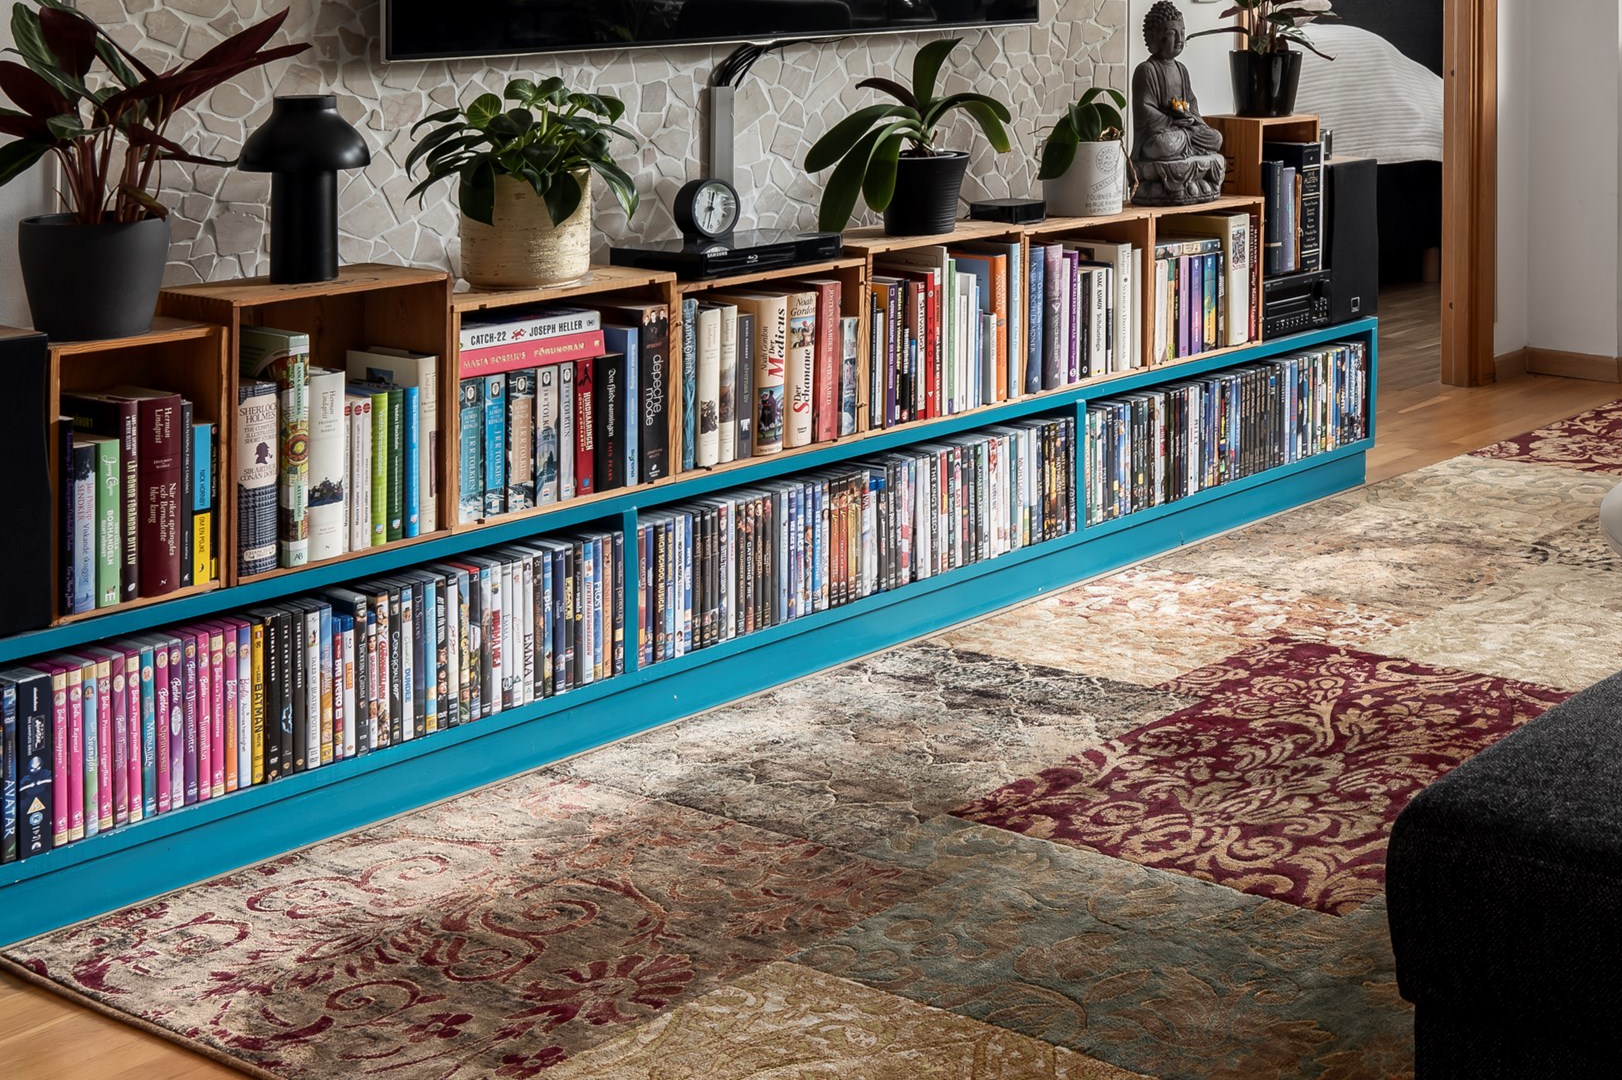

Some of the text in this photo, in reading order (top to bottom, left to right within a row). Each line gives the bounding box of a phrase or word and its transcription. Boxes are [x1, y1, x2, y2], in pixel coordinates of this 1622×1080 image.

[470, 320, 583, 346] CATCH-22 JOSEPH HELLER
[534, 342, 585, 356] FÖRUNDRAN
[768, 308, 785, 378] Medicus
[652, 354, 664, 413] depeche
[793, 349, 811, 414] Schamane
[794, 385, 802, 401] Der
[584, 392, 593, 450] HUNDRAÅRINGEN
[646, 387, 657, 426] mode
[154, 409, 162, 444] Lindqvist
[127, 460, 137, 565] LÅT BÖNOR FÖRÄNDRA DITT LIV
[148, 505, 158, 523] kung
[168, 519, 176, 556] sprängdes
[81, 556, 89, 583] skuggor
[544, 589, 552, 612] epic
[503, 613, 511, 641] EMMA
[491, 648, 501, 668] MEJ
[524, 633, 533, 677] EMMA
[172, 677, 181, 703] Barbie
[310, 676, 317, 685] OF
[334, 659, 343, 707] BIG HERO
[200, 676, 210, 760] Barbie Tummelisa
[87, 736, 96, 772] Svansjön
[145, 720, 155, 767] MERMAIDIA
[4, 779, 15, 838] AVATAR
